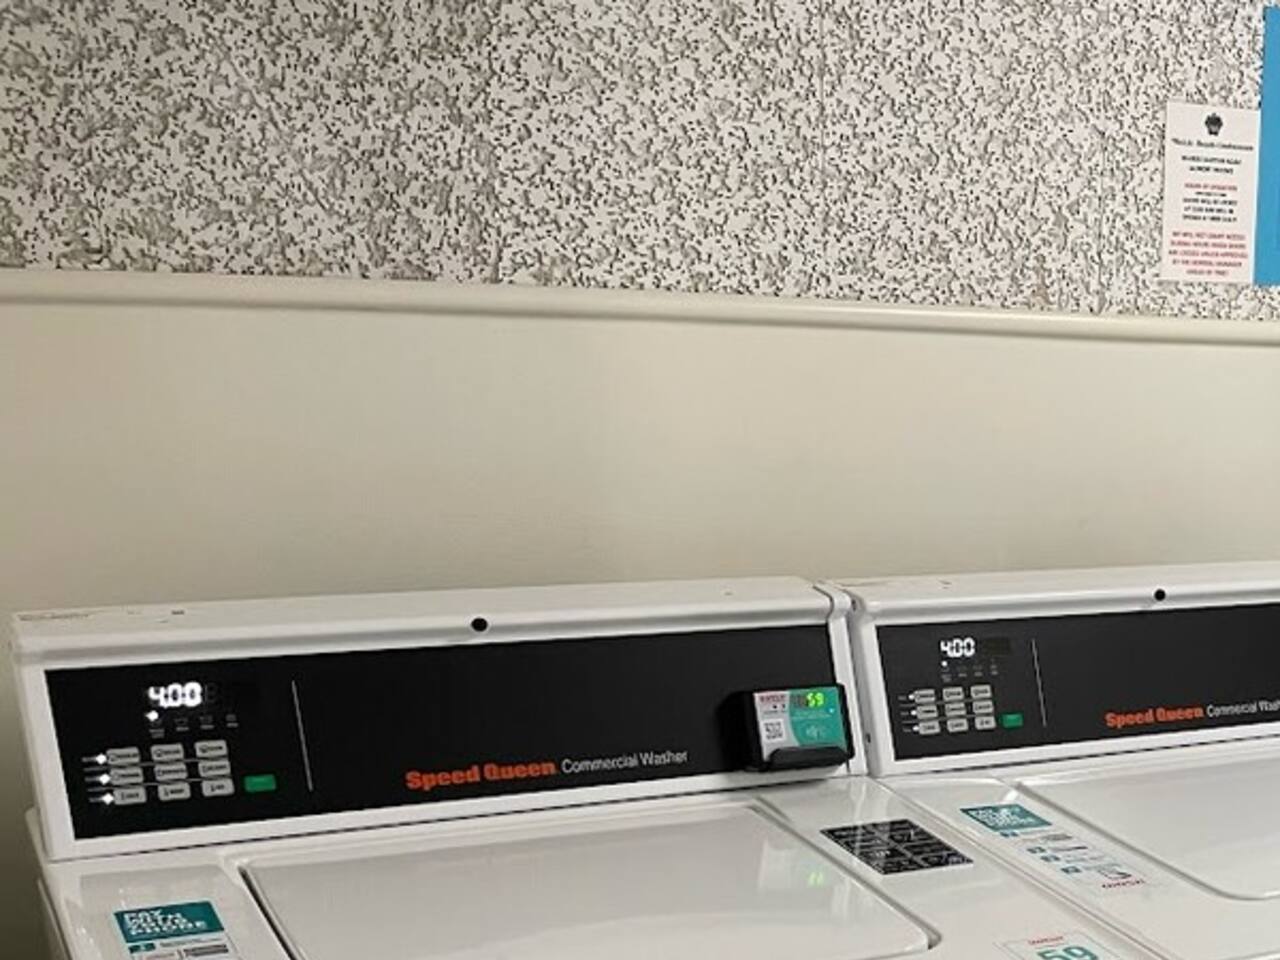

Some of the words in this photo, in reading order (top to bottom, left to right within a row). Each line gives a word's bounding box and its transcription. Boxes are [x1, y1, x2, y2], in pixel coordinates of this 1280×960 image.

[1104, 708, 1154, 729] Speed
[1156, 704, 1205, 724] Queen
[1207, 701, 1257, 718] Commercial
[405, 765, 481, 791] Speed
[483, 759, 557, 782] Queen
[561, 754, 638, 774] Commercial
[639, 749, 688, 766] Washer
